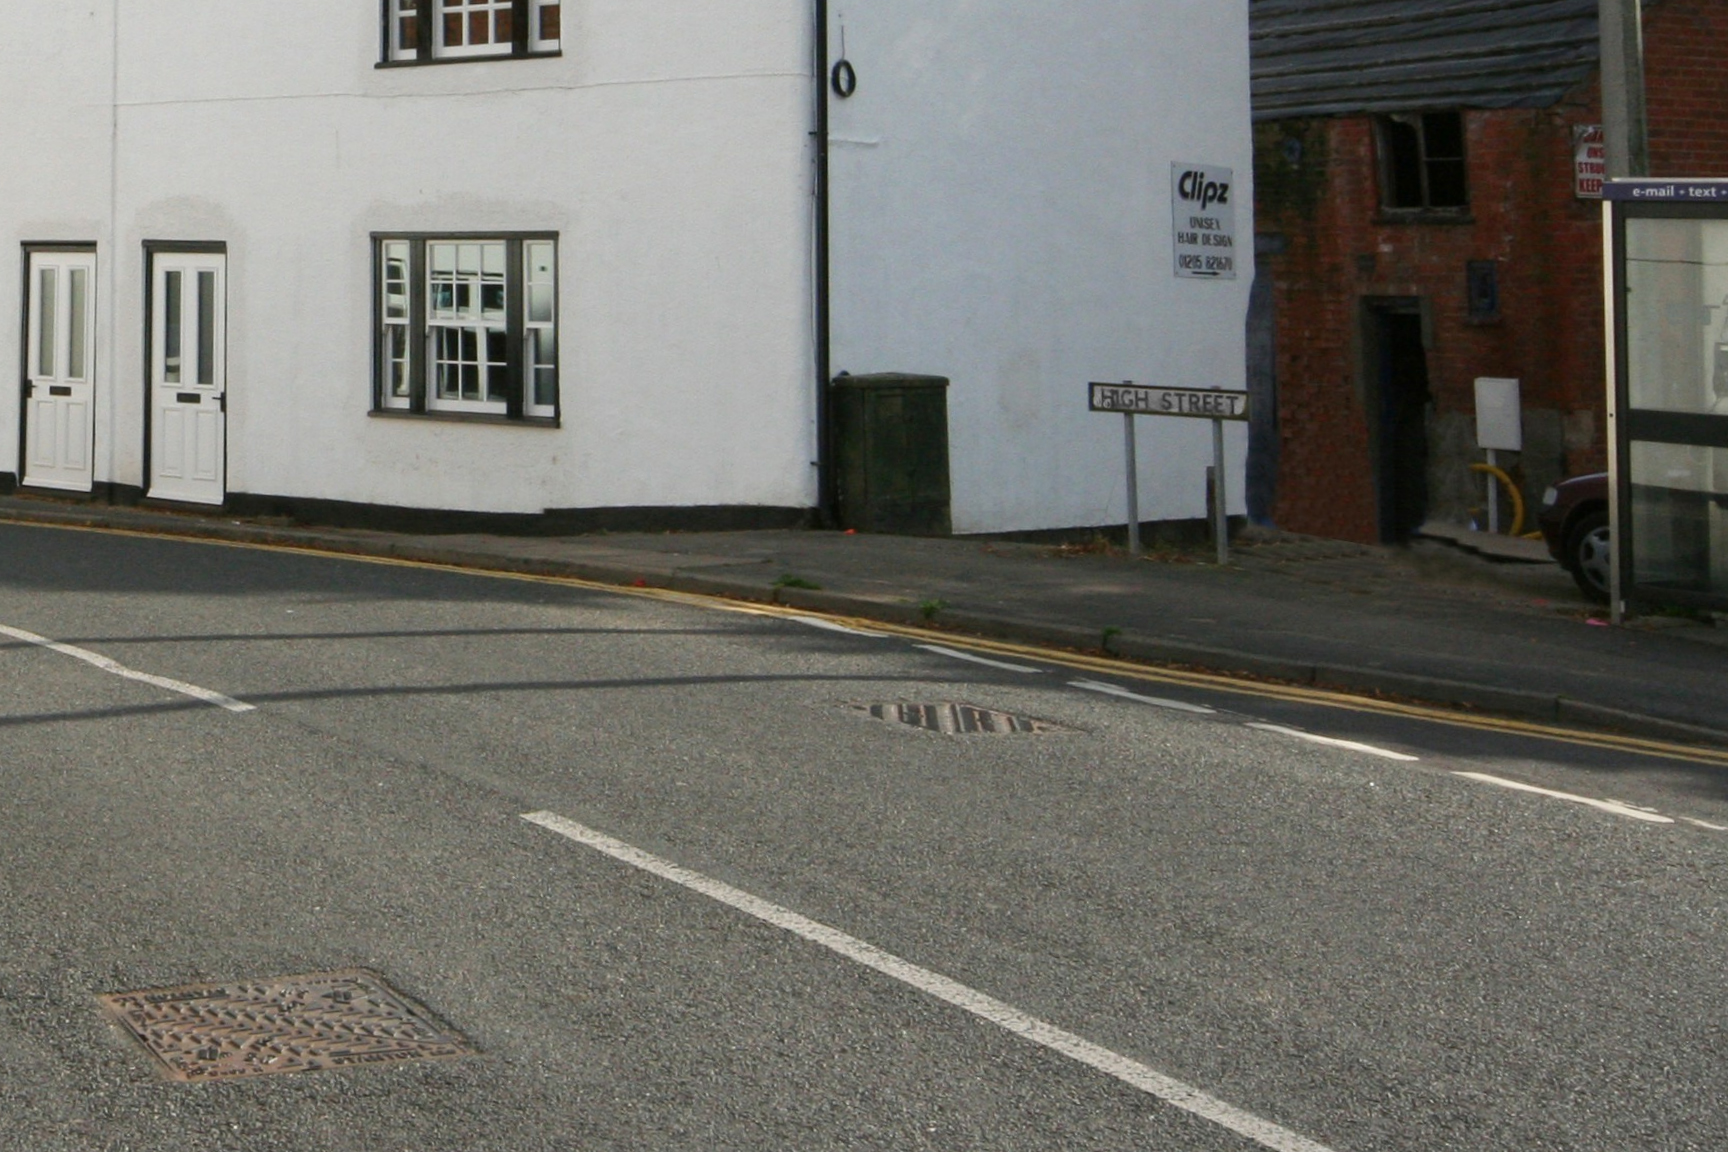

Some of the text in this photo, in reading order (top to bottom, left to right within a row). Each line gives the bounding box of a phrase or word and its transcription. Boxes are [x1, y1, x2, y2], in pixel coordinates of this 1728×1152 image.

[1178, 170, 1230, 210] Clipz
[1632, 185, 1717, 197] e-mail text
[1189, 216, 1221, 231] UNISEX
[1177, 231, 1233, 248] HAIR DESIGN
[1100, 387, 1239, 415] HIGH STREET
